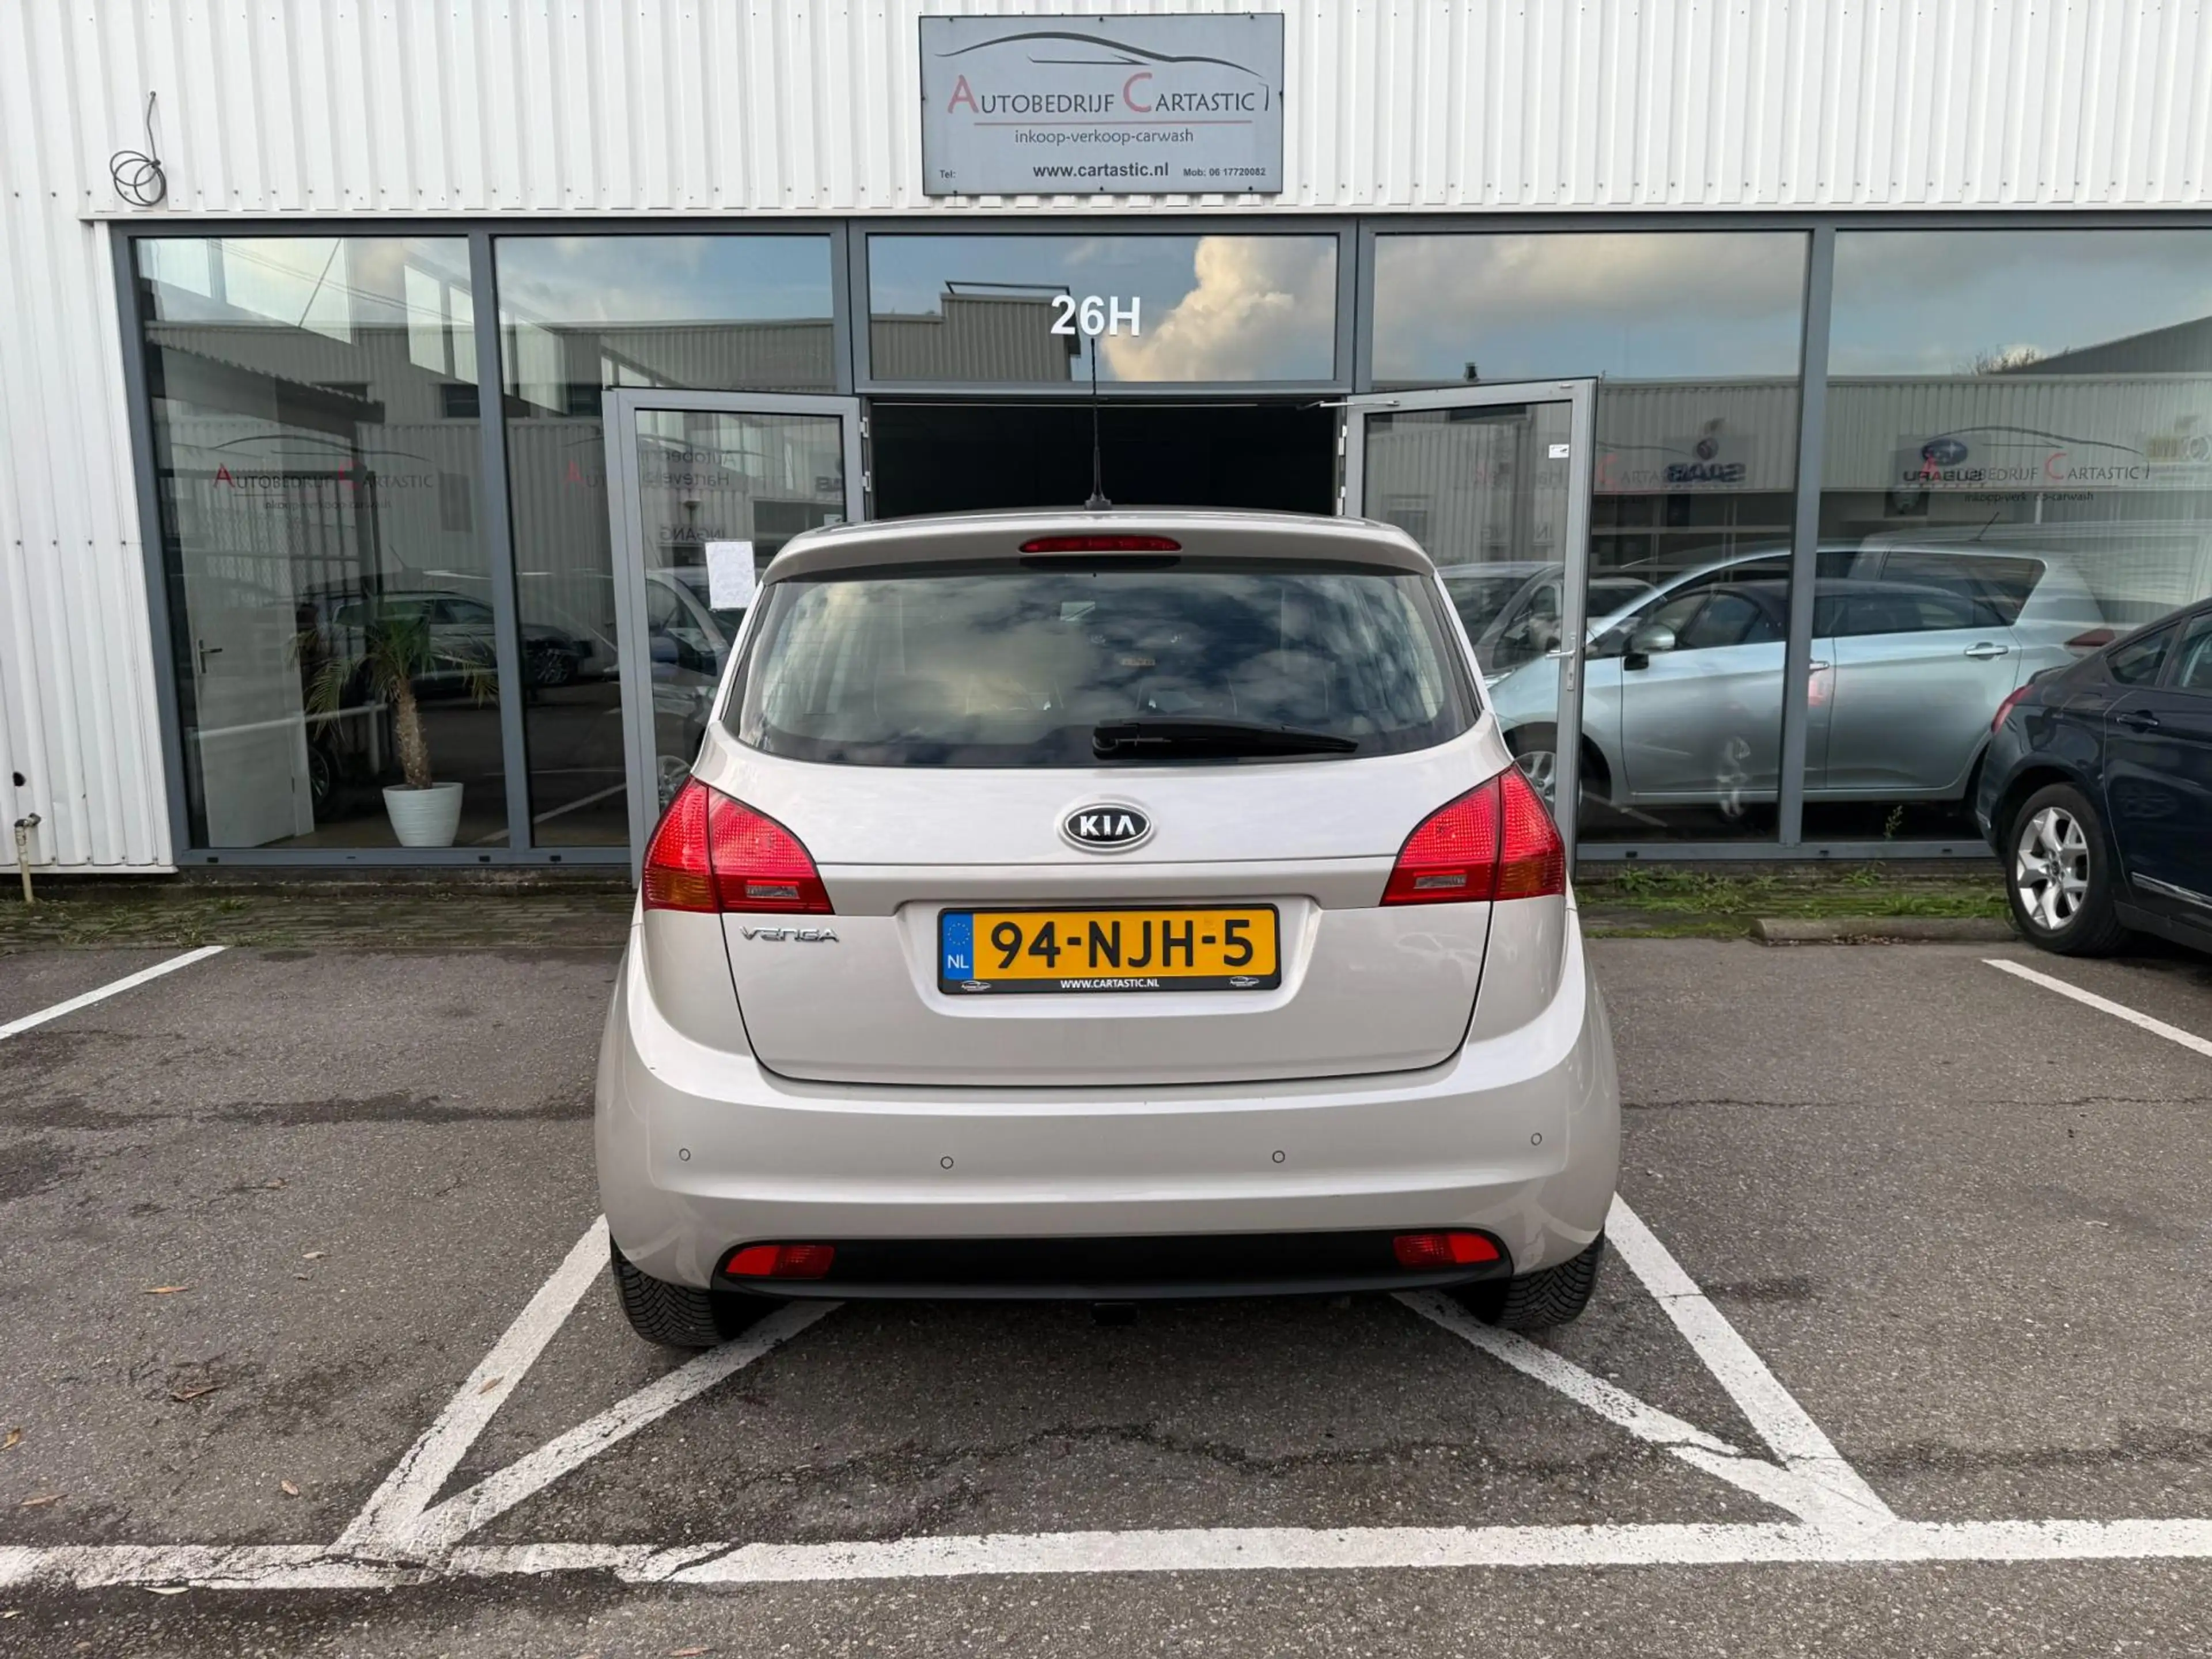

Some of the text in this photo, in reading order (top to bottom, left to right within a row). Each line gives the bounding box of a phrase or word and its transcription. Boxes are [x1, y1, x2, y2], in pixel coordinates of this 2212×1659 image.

[947, 72, 1255, 114] AUTOBEDRIJF CARTASTIC
[1014, 128, 1194, 146] inkoop-verkoop-carwash
[940, 169, 956, 179] Tel:
[1032, 162, 1169, 177] www.cartastic.nl
[1183, 168, 1207, 176] Mob:
[1209, 168, 1220, 176] 06
[1050, 294, 1141, 337] 26H
[2045, 452, 2139, 480] CARTASTIC
[1080, 815, 1136, 836] KIA
[948, 919, 1254, 969] NL 94-NJH-5
[1060, 978, 1160, 990] WWW.CARTASTIC.NL
